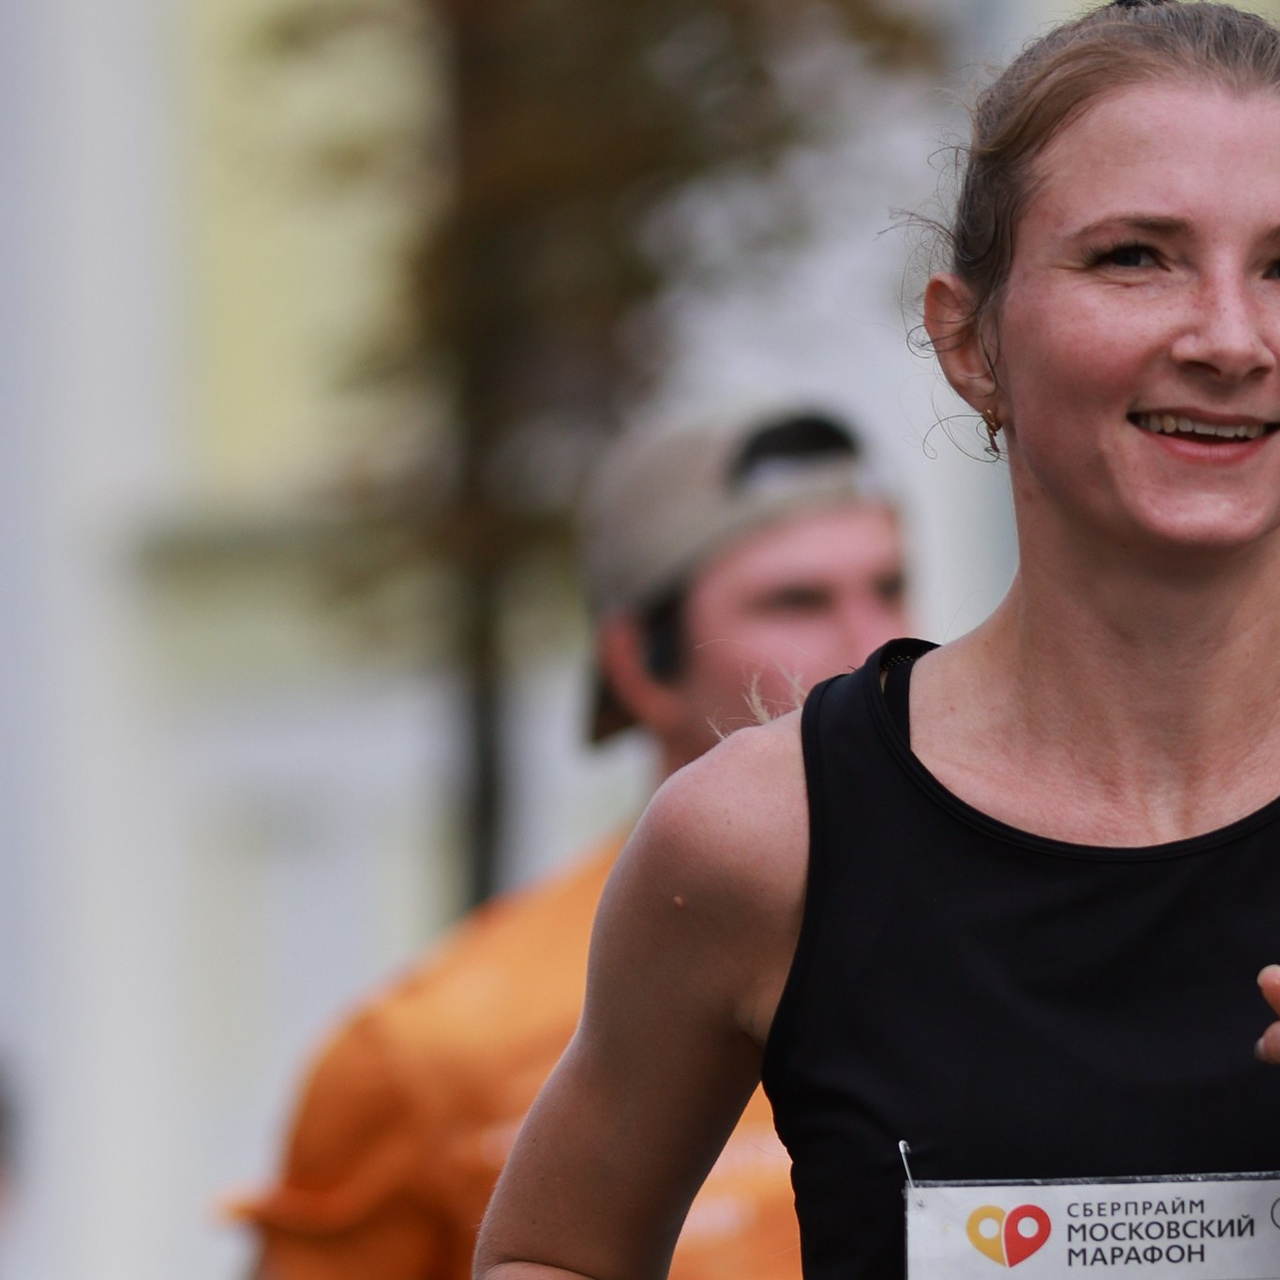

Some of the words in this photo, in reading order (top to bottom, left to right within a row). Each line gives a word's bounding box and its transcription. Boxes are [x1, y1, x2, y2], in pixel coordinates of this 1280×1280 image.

[1067, 1196, 1204, 1218] СБЕРПРАЙМ
[1067, 1214, 1255, 1242] МОСКОВСКИЙ
[1067, 1244, 1205, 1267] МАРАФОН
